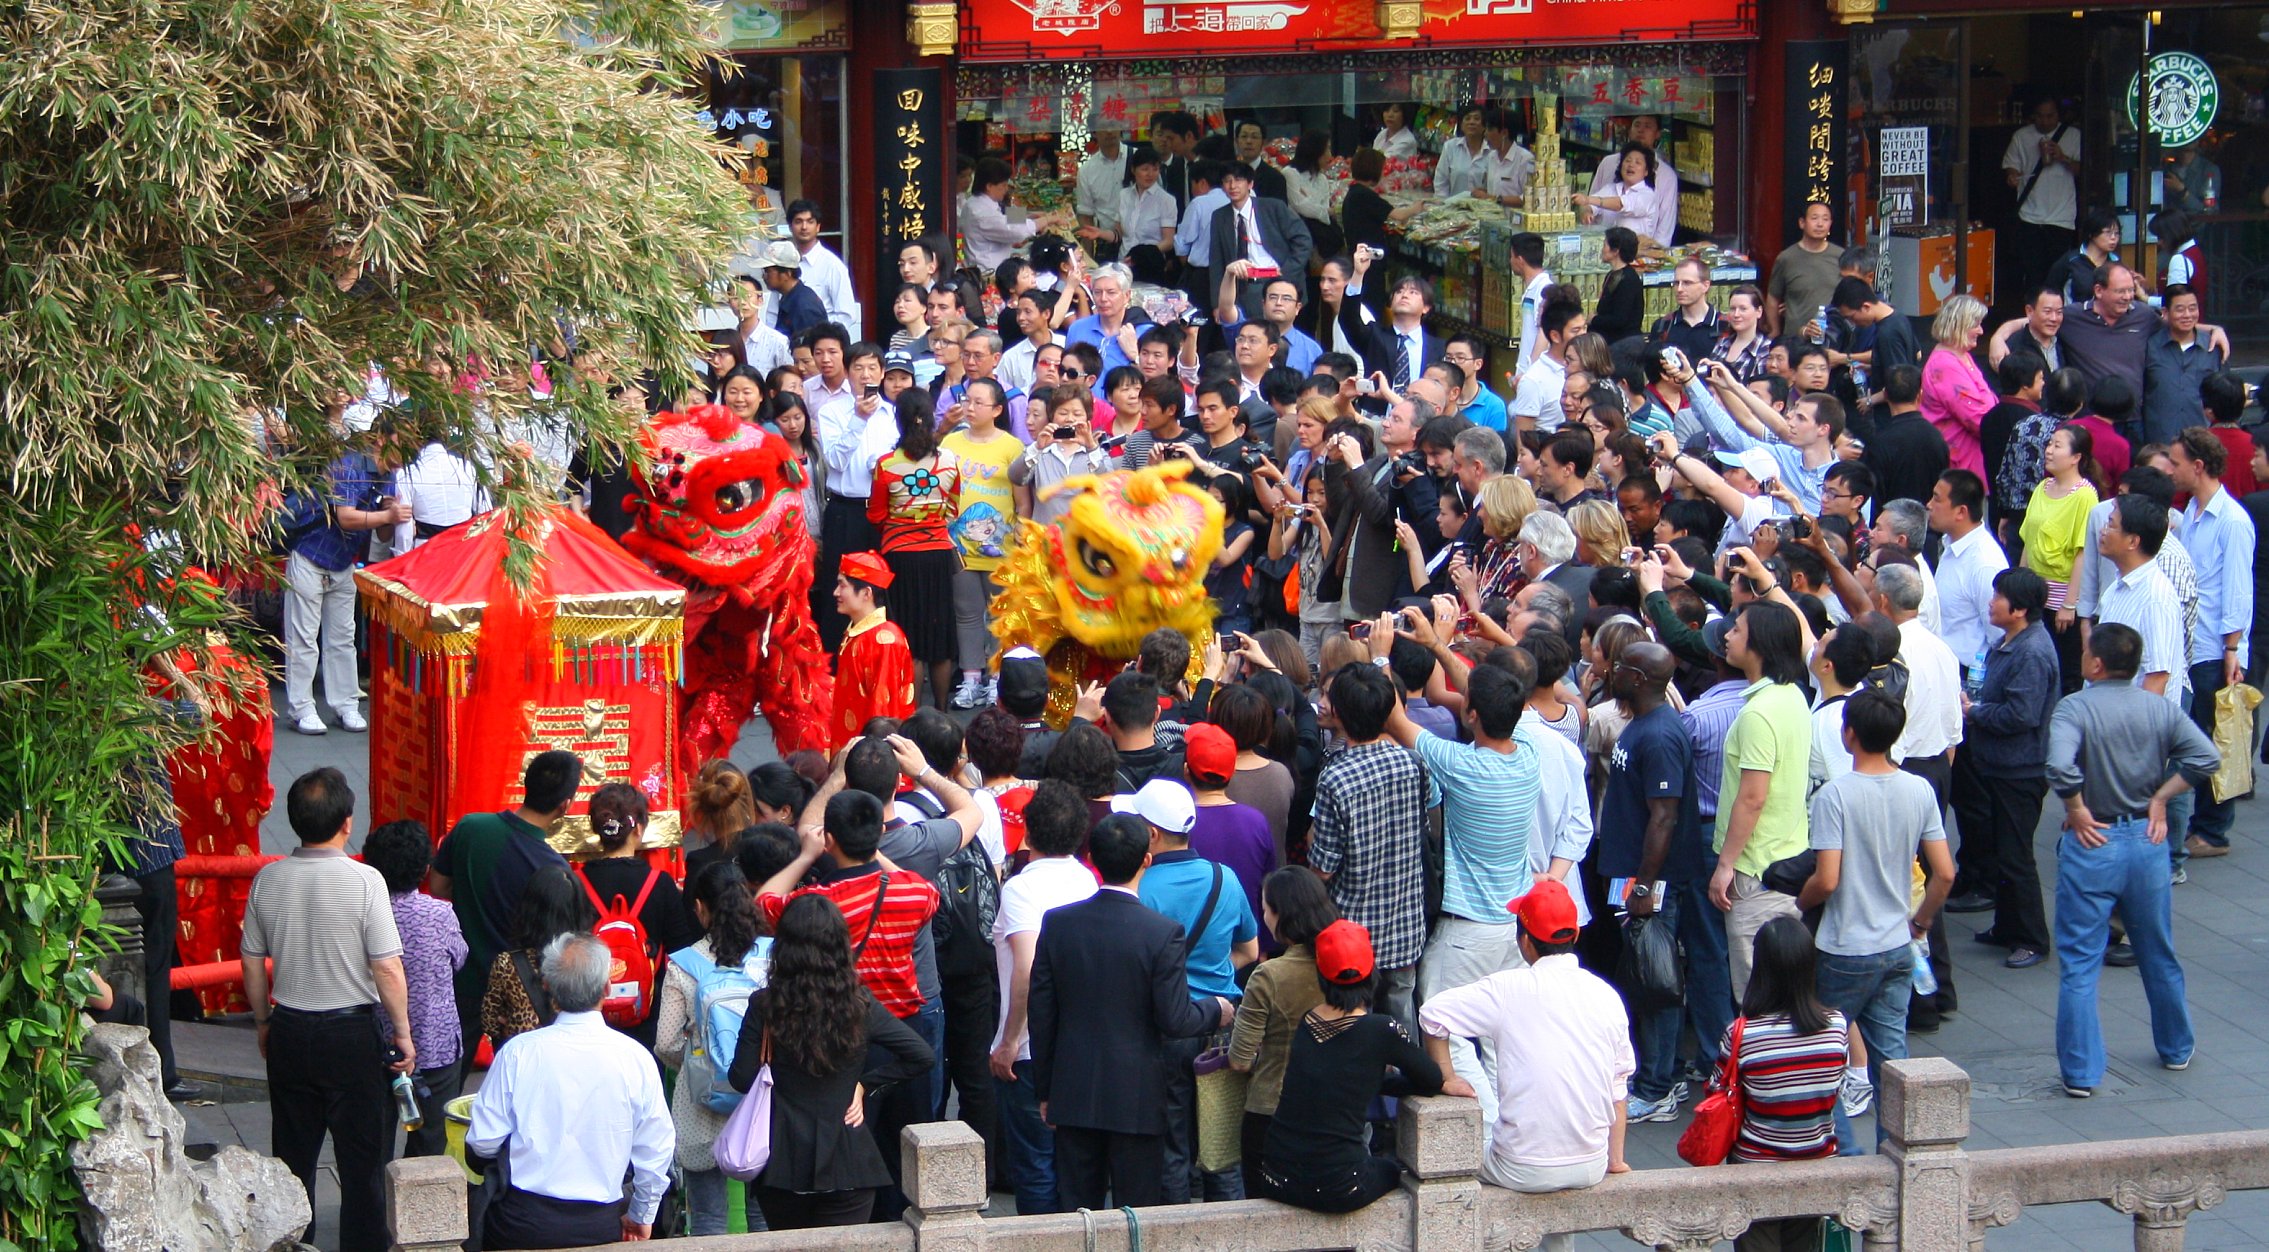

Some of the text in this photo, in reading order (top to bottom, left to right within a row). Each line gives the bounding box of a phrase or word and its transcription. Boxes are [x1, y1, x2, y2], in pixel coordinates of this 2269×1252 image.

[2132, 55, 2214, 97] SARBUCKS
[1882, 130, 1926, 140] NEVER BE
[2148, 116, 2204, 142] OFFEE
[1882, 140, 1925, 150] WITHOUT
[1882, 149, 1925, 163] GREAT
[1882, 162, 1925, 174] COFFEE
